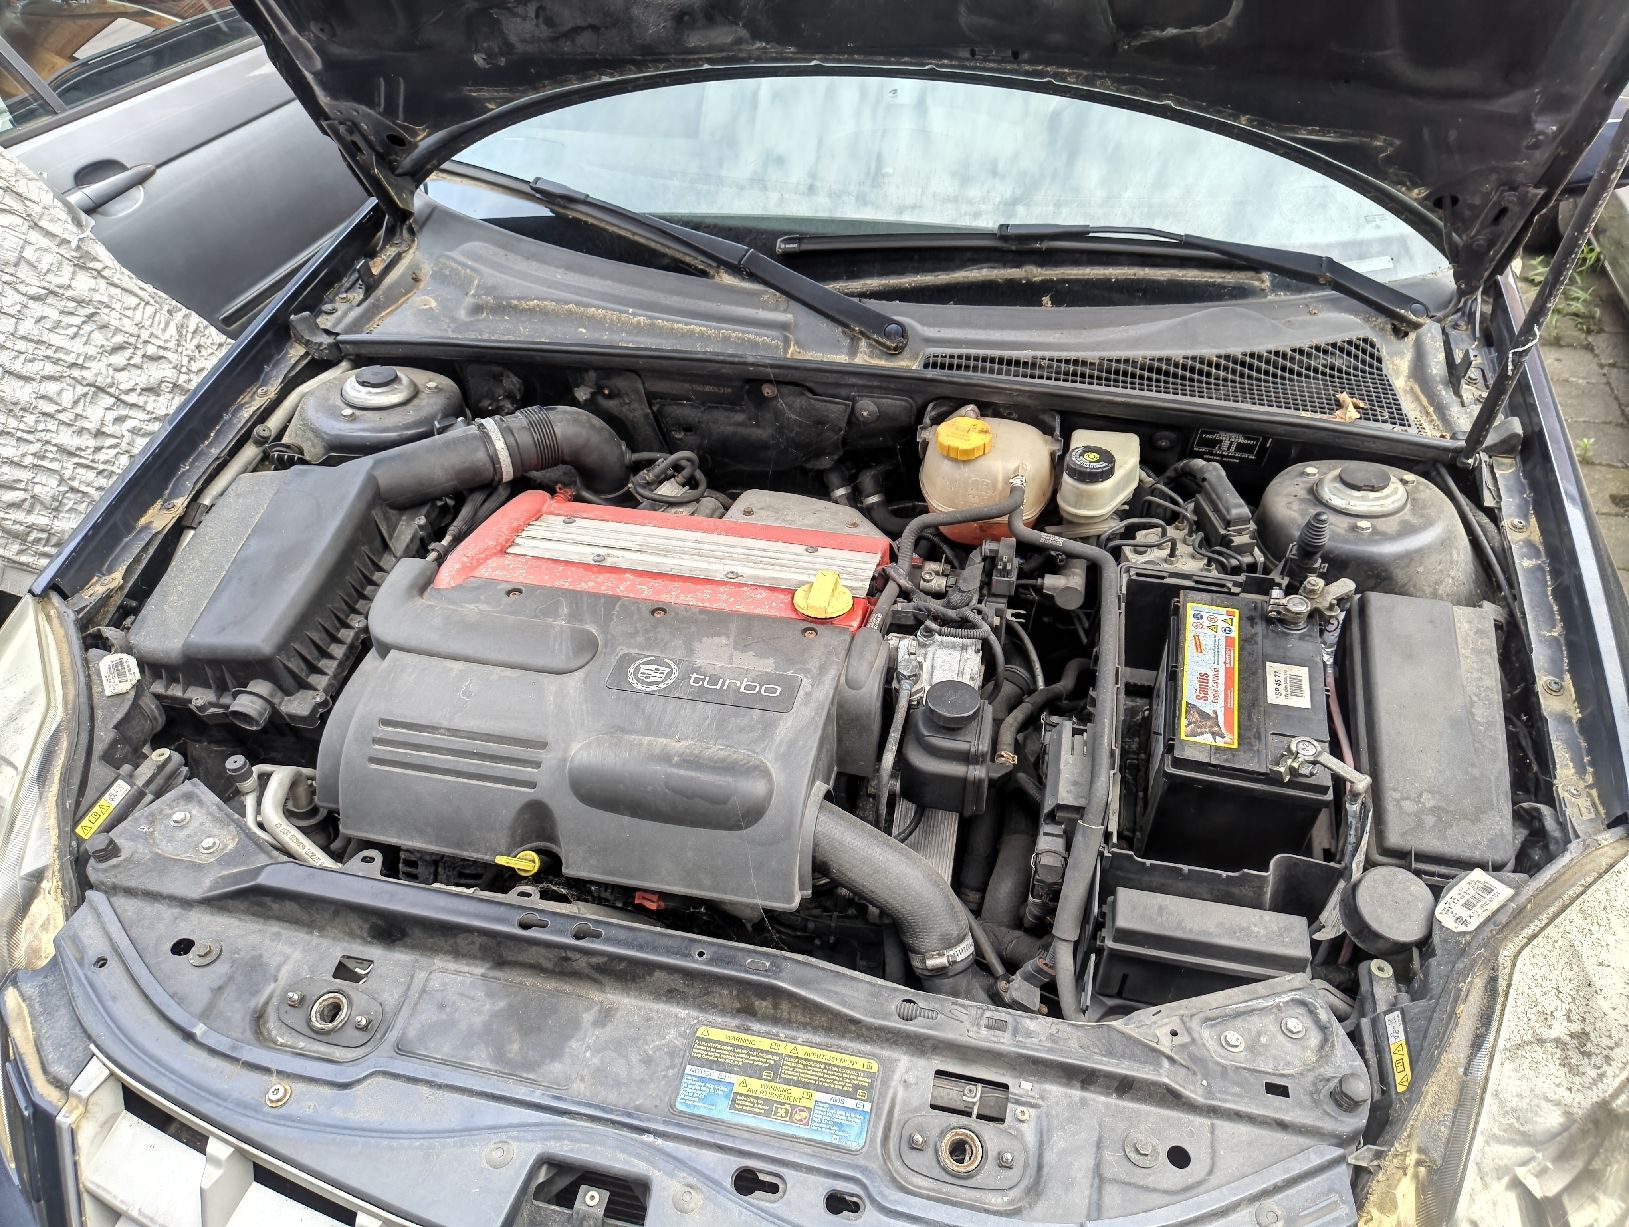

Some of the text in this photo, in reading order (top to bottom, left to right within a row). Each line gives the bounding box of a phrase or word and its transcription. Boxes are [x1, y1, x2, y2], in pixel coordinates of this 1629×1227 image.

[689, 672, 781, 697] turbo
[1194, 672, 1210, 702] Säntis
[725, 1034, 757, 1046] WARNING
[760, 1082, 792, 1095] WARNING
